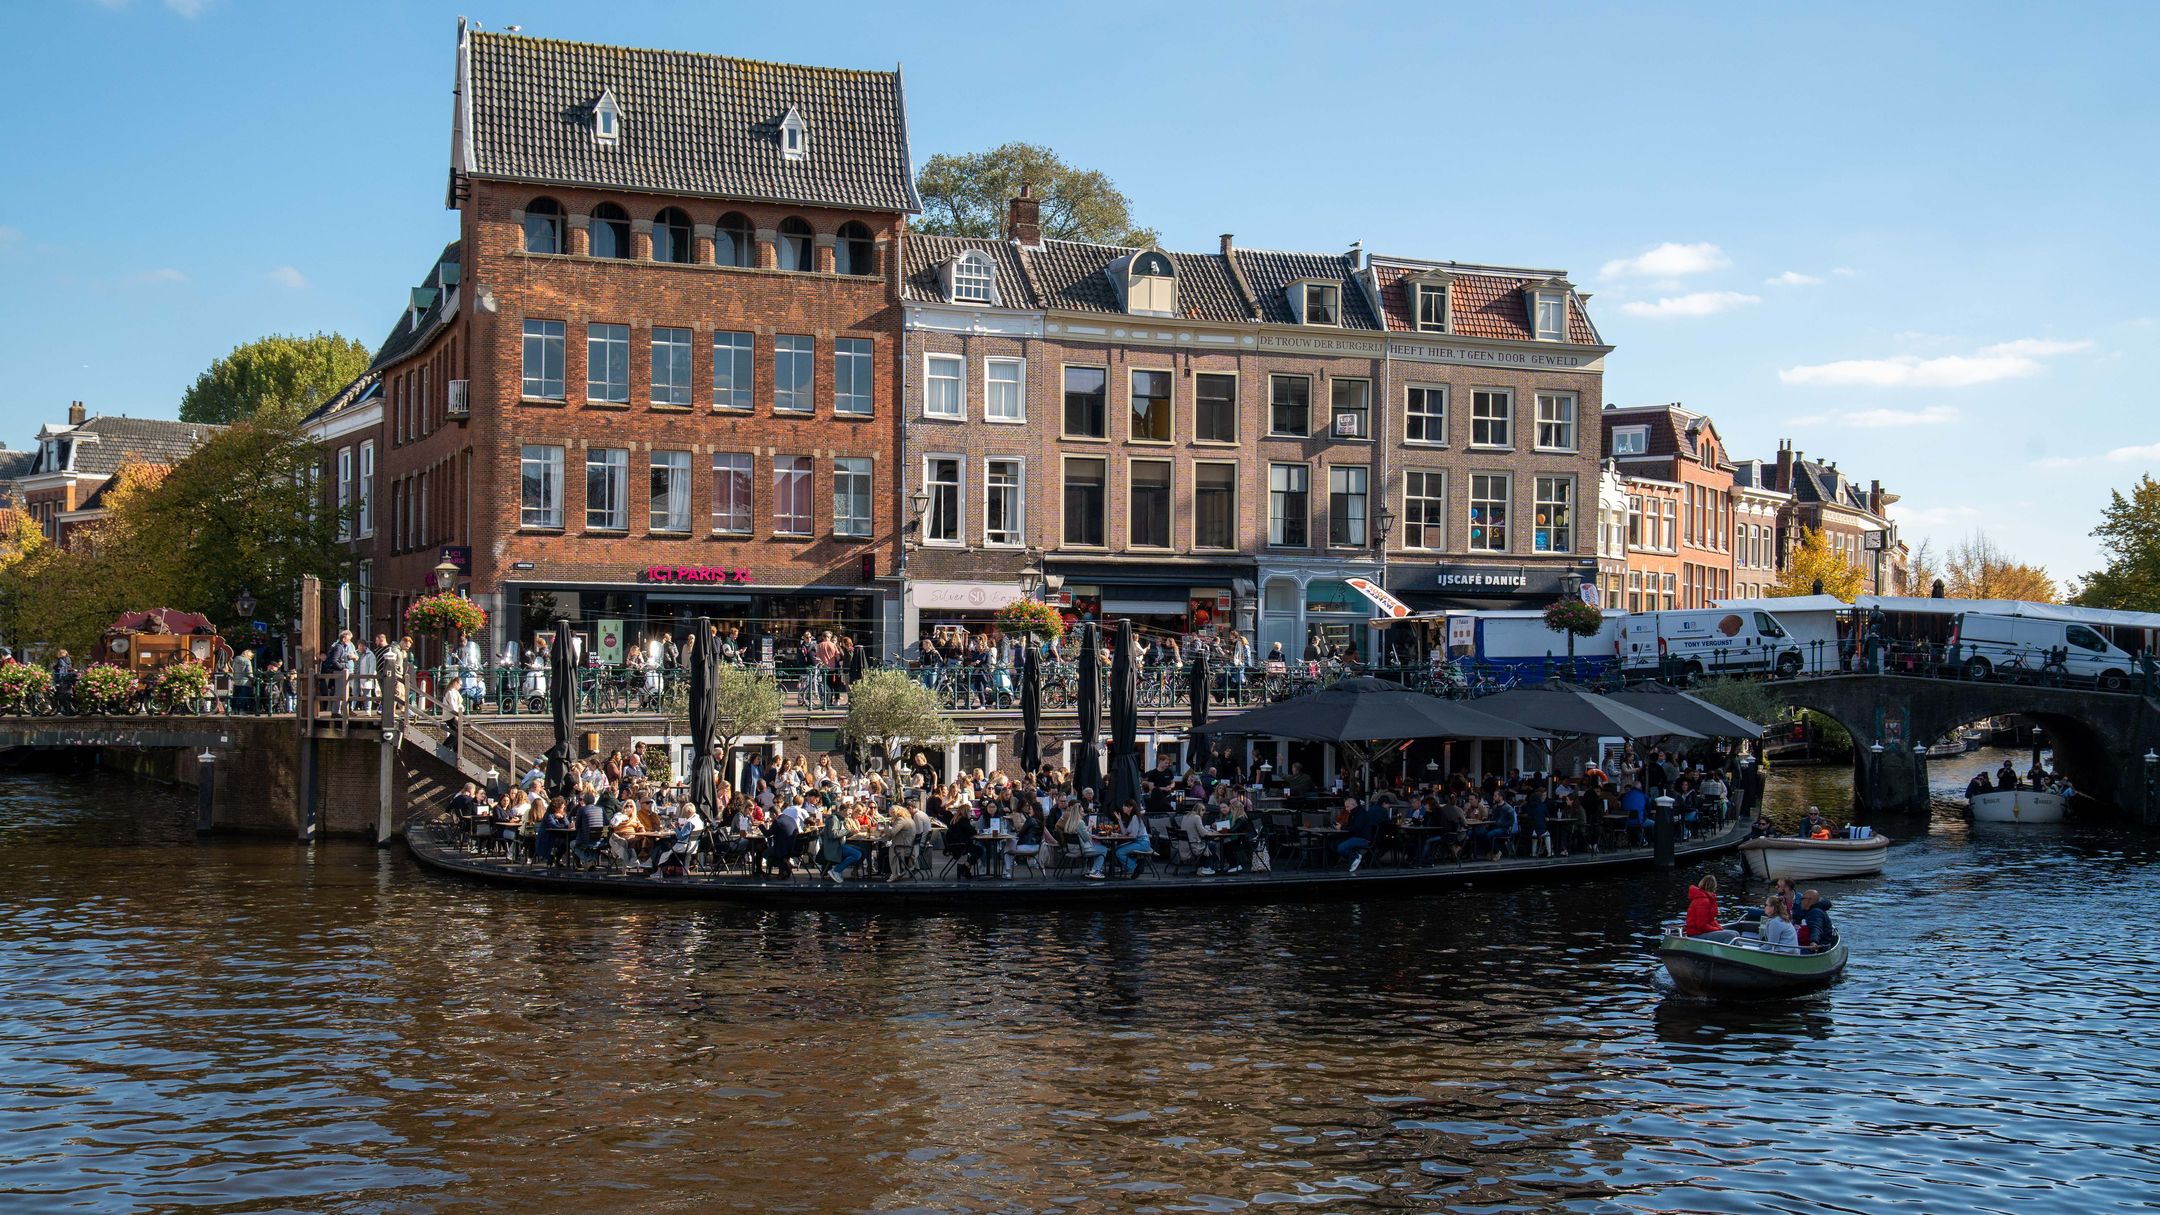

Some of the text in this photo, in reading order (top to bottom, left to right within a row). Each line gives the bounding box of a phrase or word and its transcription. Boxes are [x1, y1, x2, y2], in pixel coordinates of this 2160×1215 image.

[1260, 336, 1383, 352] DE TROUW DER BURGERIJ
[1390, 344, 1425, 356] HEEFT
[1467, 350, 1494, 360] GEEN
[1498, 352, 1525, 363] DOOR
[1531, 354, 1578, 366] GEWELD
[649, 565, 753, 582] ICI PARIS XL
[1438, 573, 1526, 586] IJSCAFÉ DANICE
[931, 588, 964, 602] Silver
[1701, 639, 1733, 647] VERGUNST
